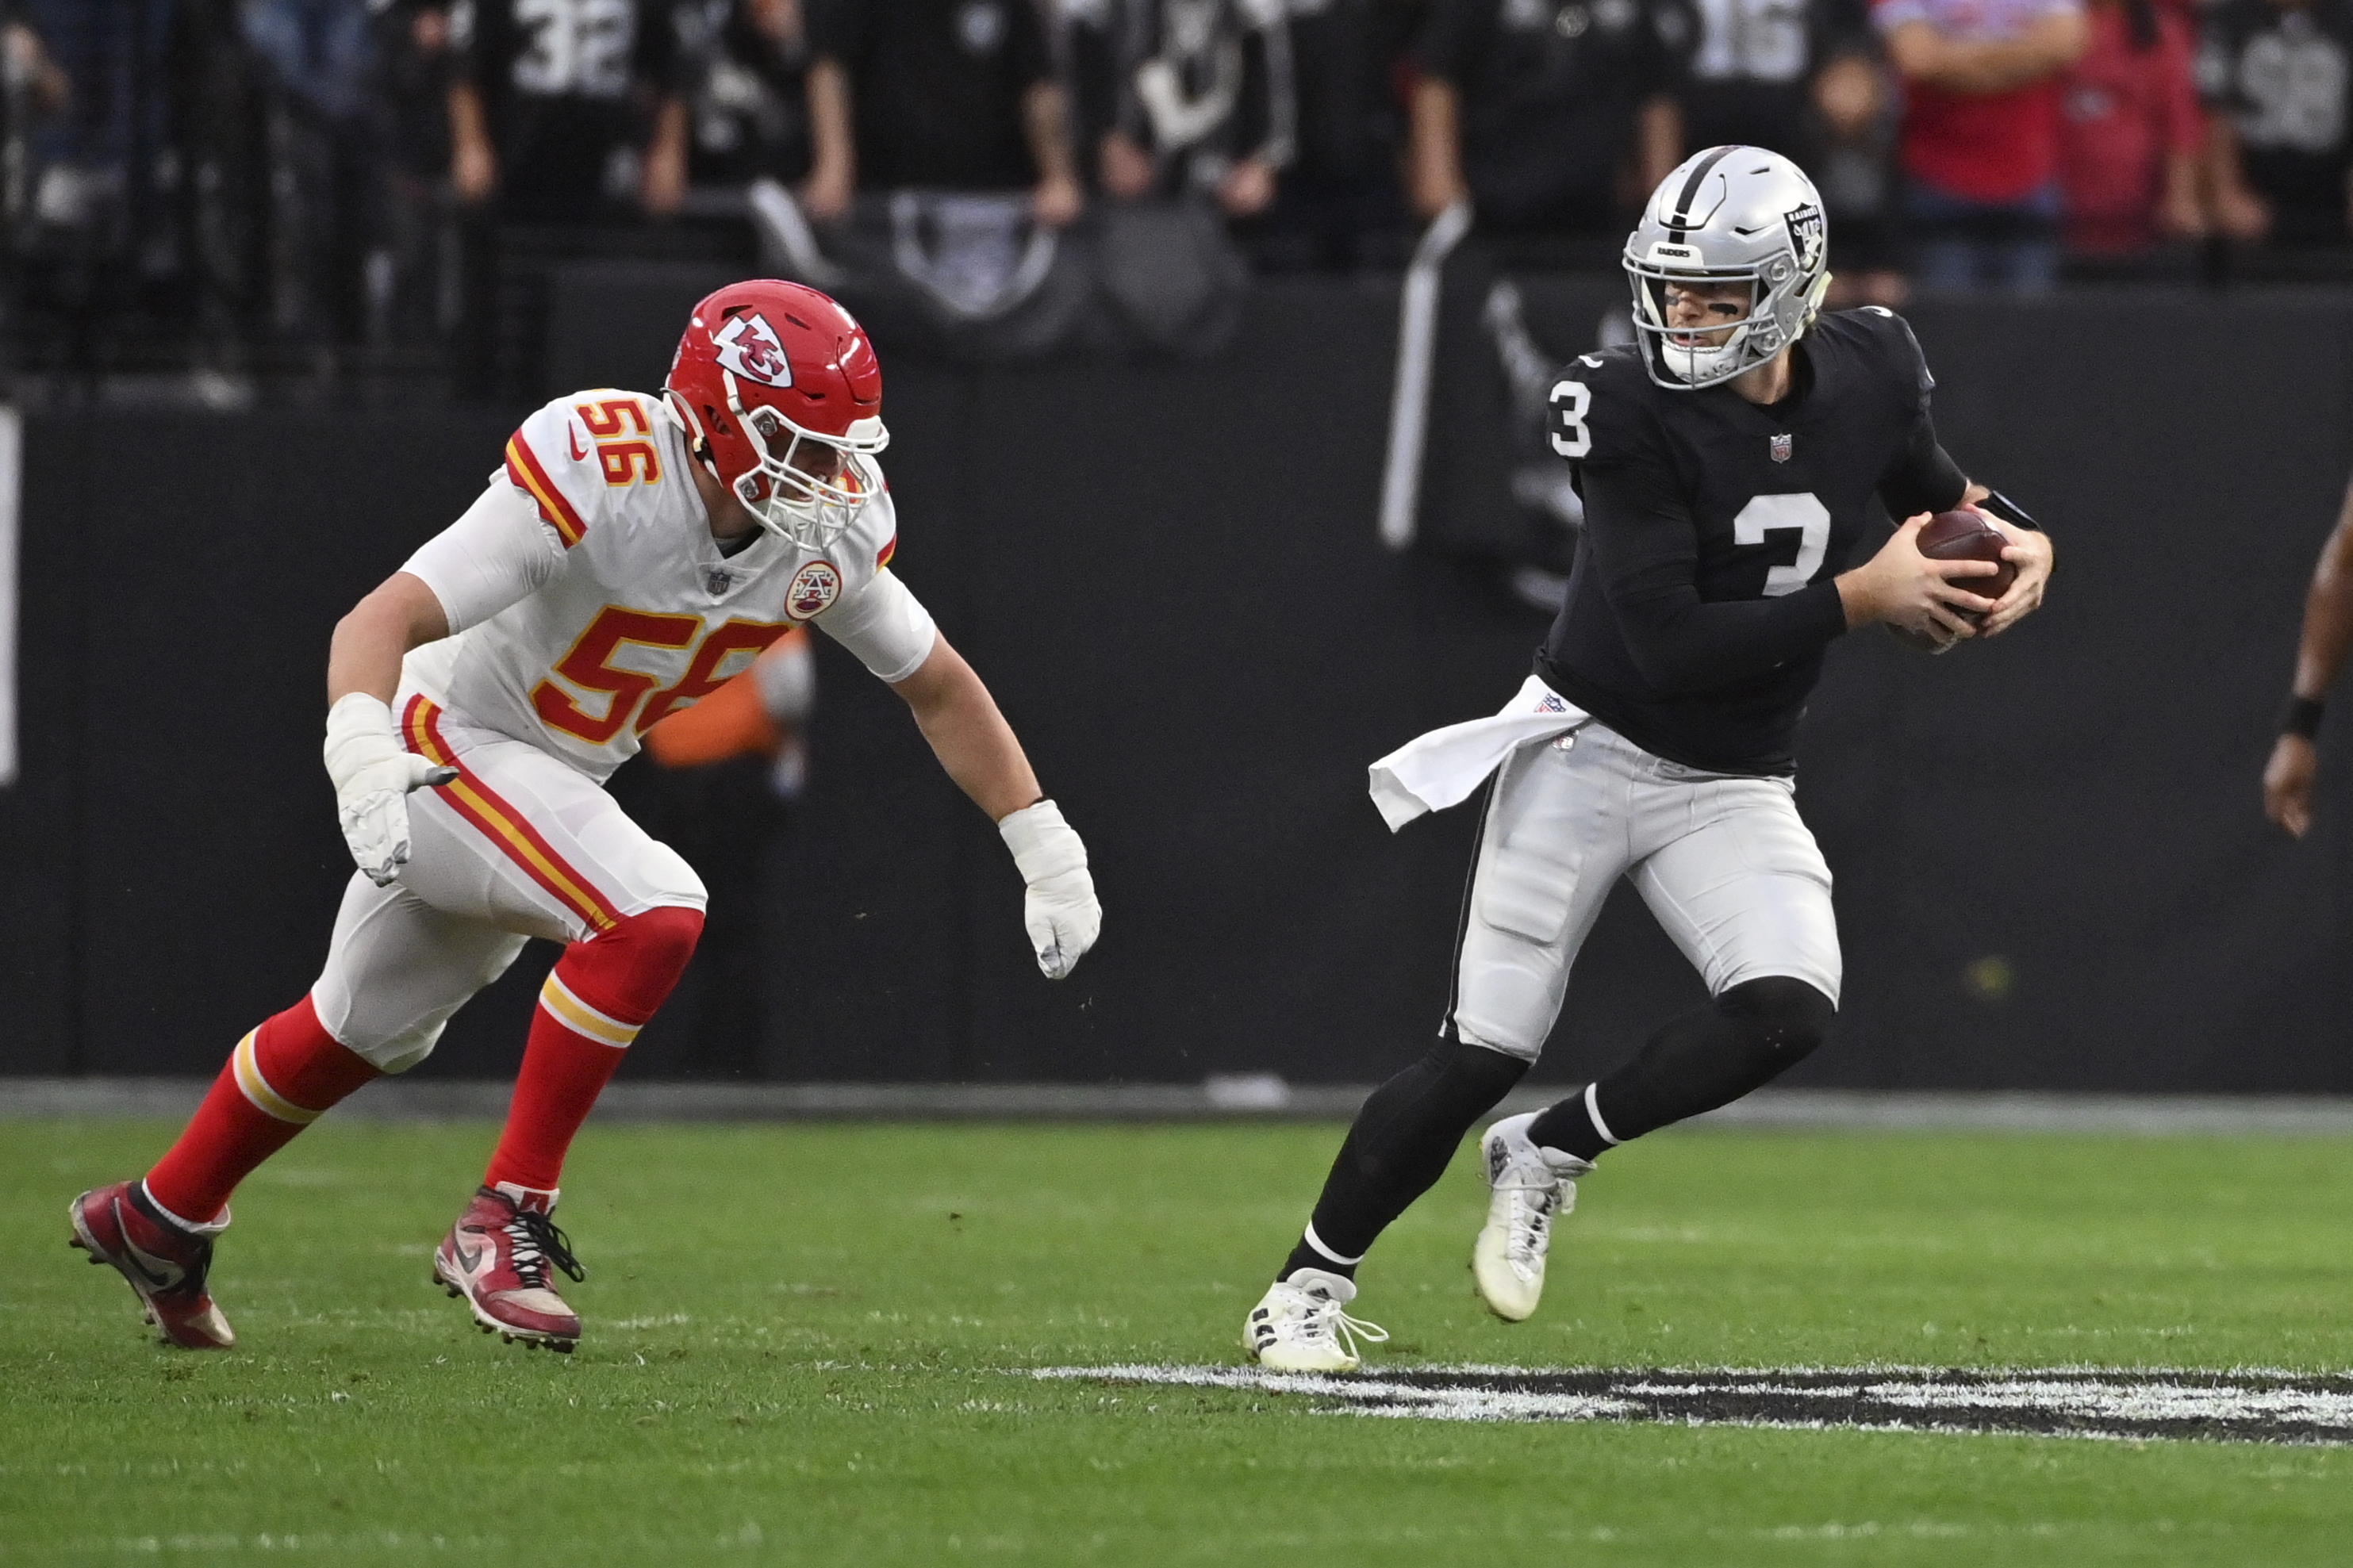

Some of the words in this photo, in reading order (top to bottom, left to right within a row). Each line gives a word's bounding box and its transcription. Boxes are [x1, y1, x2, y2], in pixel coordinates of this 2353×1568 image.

[514, 0, 633, 92] 32
[576, 398, 662, 487] 56
[1549, 381, 1592, 458] 3
